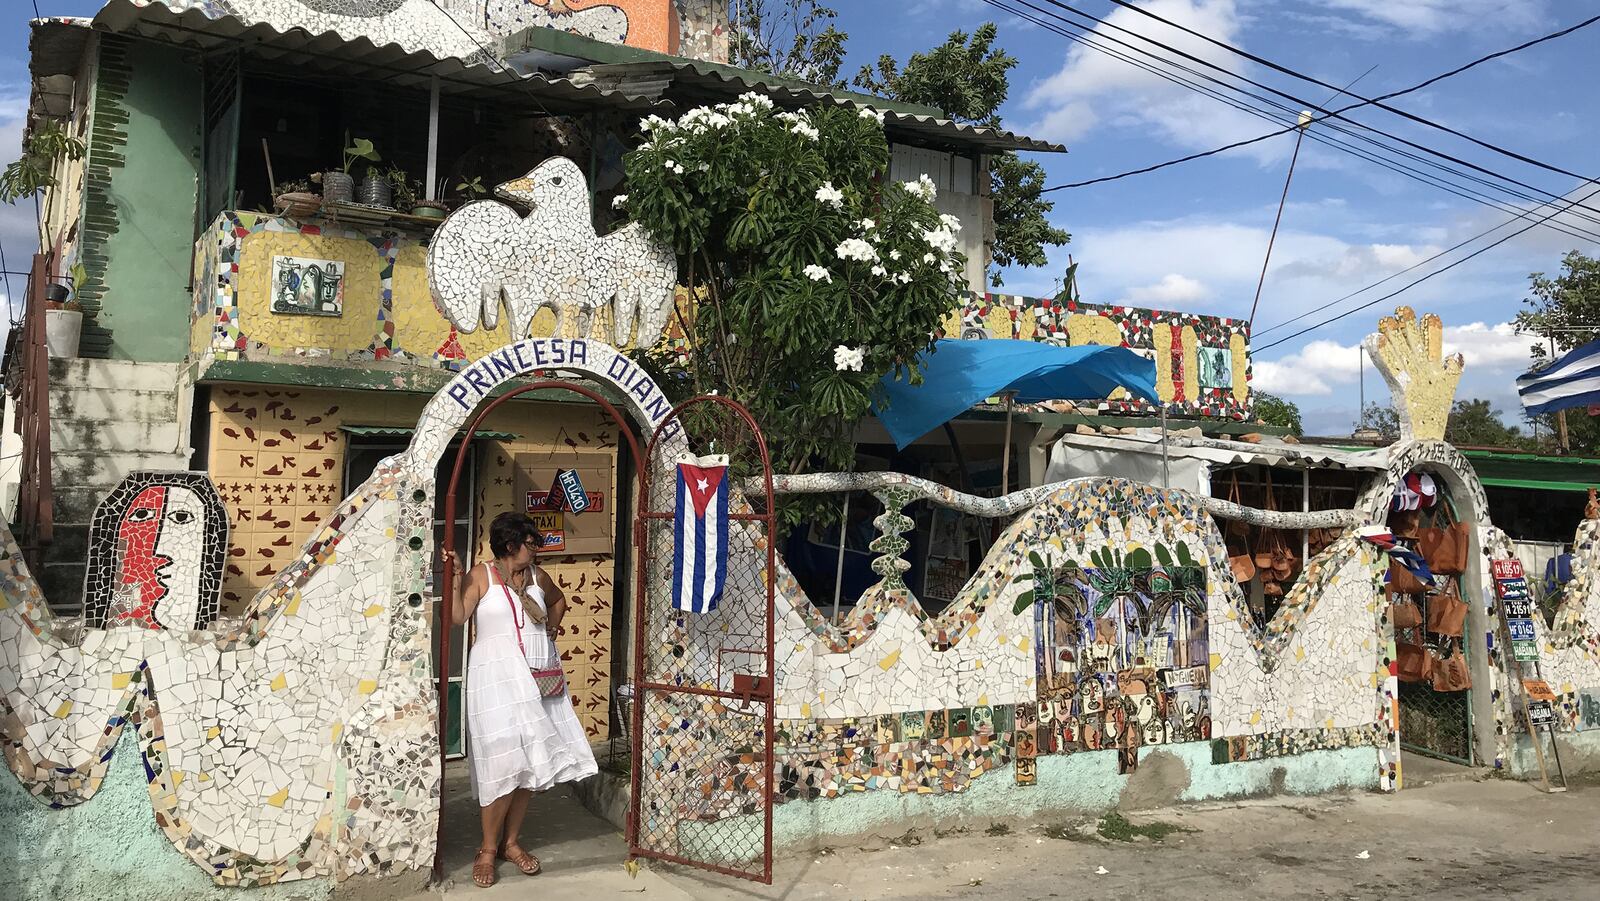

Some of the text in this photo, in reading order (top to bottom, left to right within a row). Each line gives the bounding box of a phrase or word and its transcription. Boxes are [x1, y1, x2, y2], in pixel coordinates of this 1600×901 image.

[448, 339, 680, 443] PRINCESA DIANA
[533, 516, 556, 528] TAXI
[1505, 605, 1531, 615] H 21591
[1518, 625, 1534, 635] 0162
[1513, 646, 1537, 656] HABANA
[1529, 708, 1551, 718] HABANA
